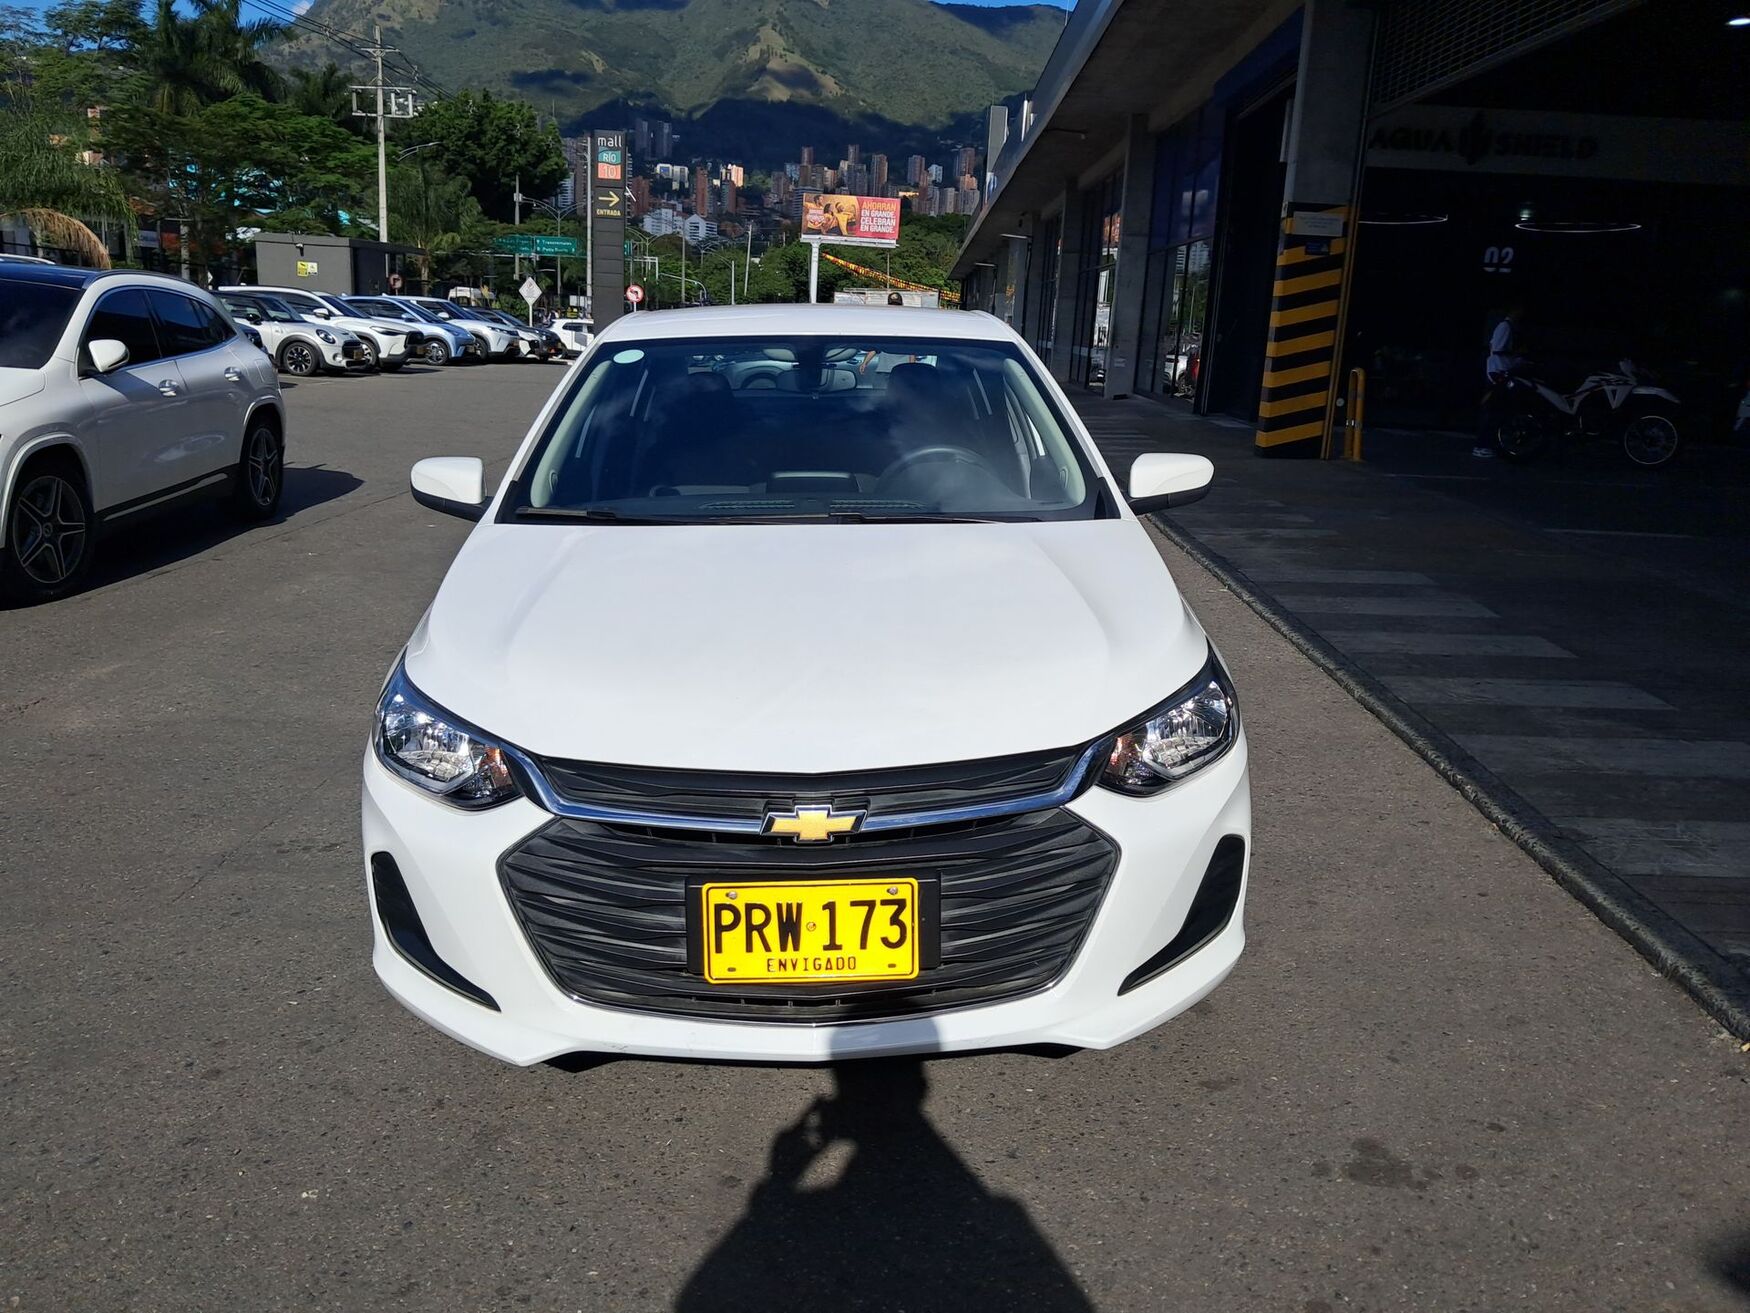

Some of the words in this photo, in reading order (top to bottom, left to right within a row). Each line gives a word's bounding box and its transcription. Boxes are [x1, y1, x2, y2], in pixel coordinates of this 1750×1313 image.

[597, 135, 622, 147] mall
[1368, 128, 1453, 151] AQUA
[596, 208, 621, 216] ENTRADA
[862, 201, 897, 211] AHORRAN
[860, 217, 896, 225] CELEBRAN
[1483, 246, 1514, 273] 02
[714, 901, 802, 953] PRW
[822, 899, 908, 951] 173
[767, 956, 856, 972] ENVIGADO
